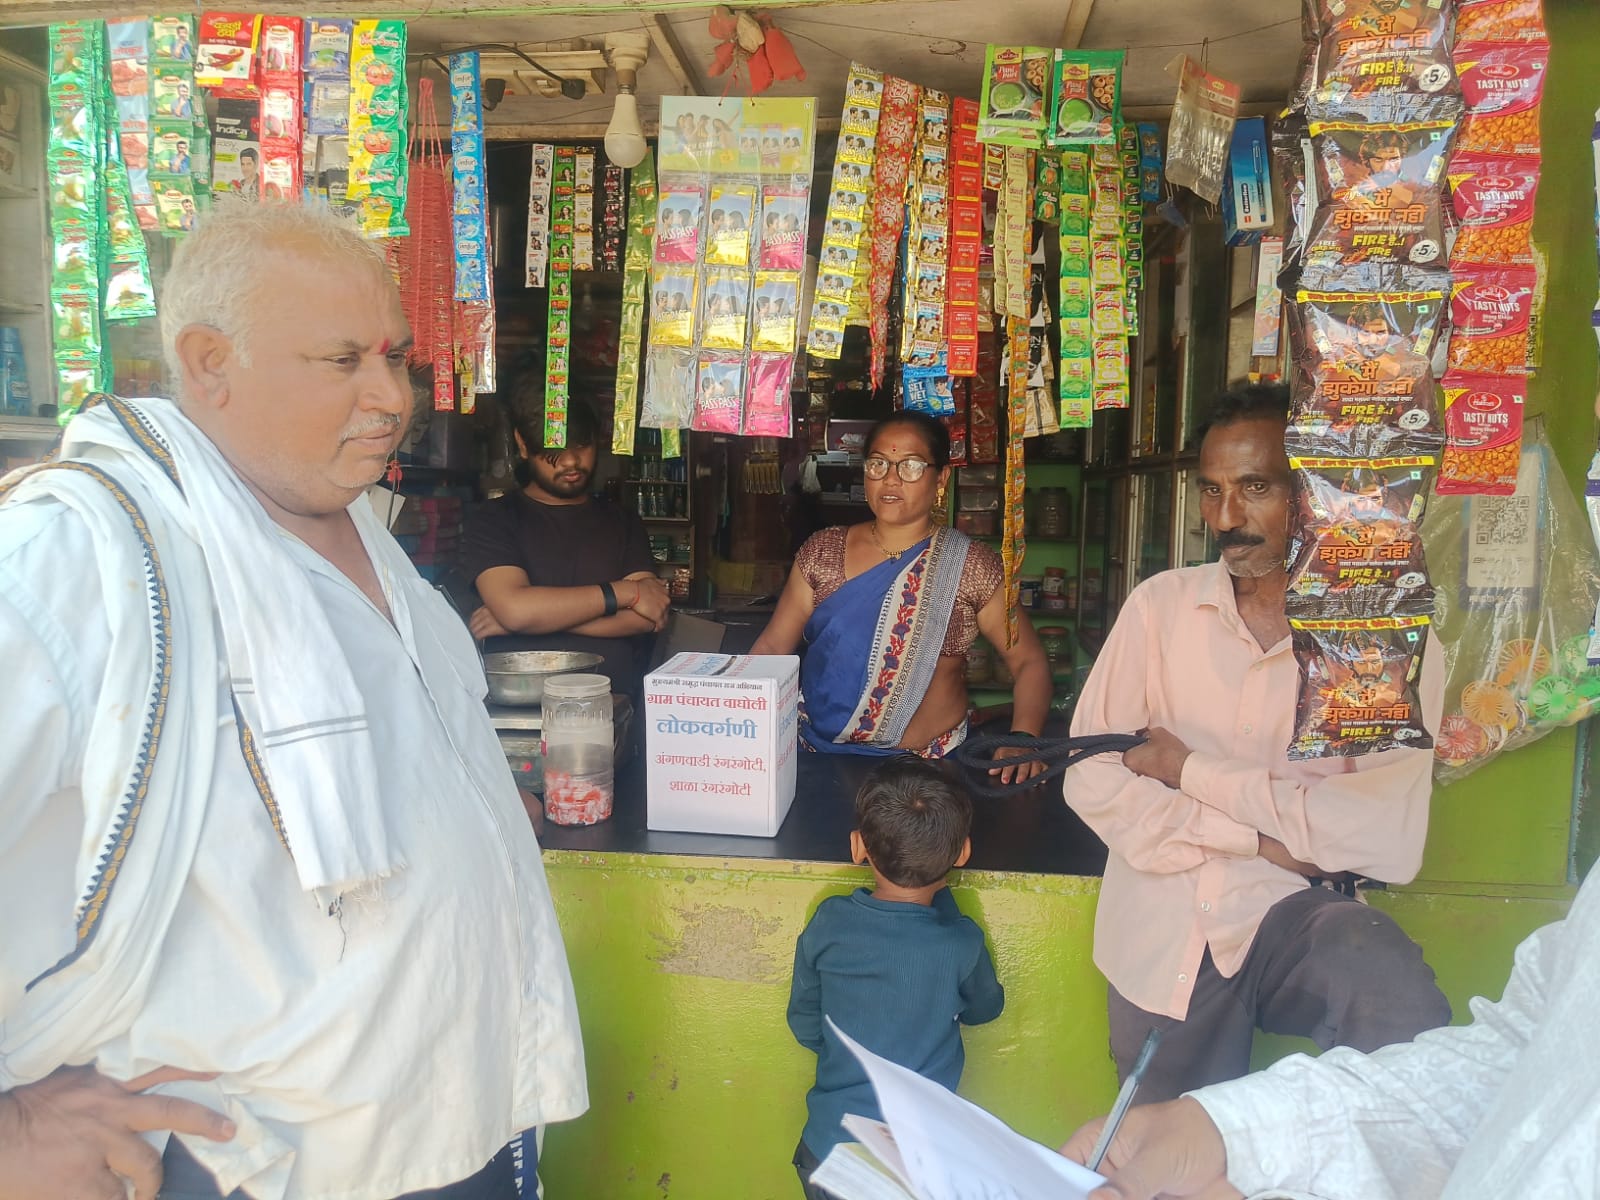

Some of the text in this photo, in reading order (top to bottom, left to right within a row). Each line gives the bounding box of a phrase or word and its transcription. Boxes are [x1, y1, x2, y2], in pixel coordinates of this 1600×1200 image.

[1360, 62, 1394, 76] FIRE
[1375, 76, 1400, 86] FIRE
[1476, 79, 1529, 89] TASTY NUTS
[216, 124, 248, 136] Indica
[1474, 190, 1525, 200] TASTY NUTS
[1334, 203, 1392, 230] झुकेगा
[1352, 234, 1387, 247] FIRE
[1366, 247, 1392, 257] FIRE
[1473, 301, 1520, 312] TASTY NUTS
[908, 381, 923, 391] SET
[909, 389, 926, 401] WET
[700, 396, 737, 411] PASS PASS
[1341, 404, 1376, 416] FIRE
[1463, 411, 1508, 424] TASTY NUTS
[1319, 541, 1375, 566] झुकेगा
[1339, 568, 1373, 579] FIRE
[647, 693, 768, 711] ग्राम पंचायत वाघोली
[656, 714, 758, 739] लोकवर्गणी
[1340, 726, 1374, 737] FIRE
[656, 751, 767, 772] अंगणवाडी रंगरंगोटी,
[669, 780, 751, 796] शाळा रंगरंगोटी
